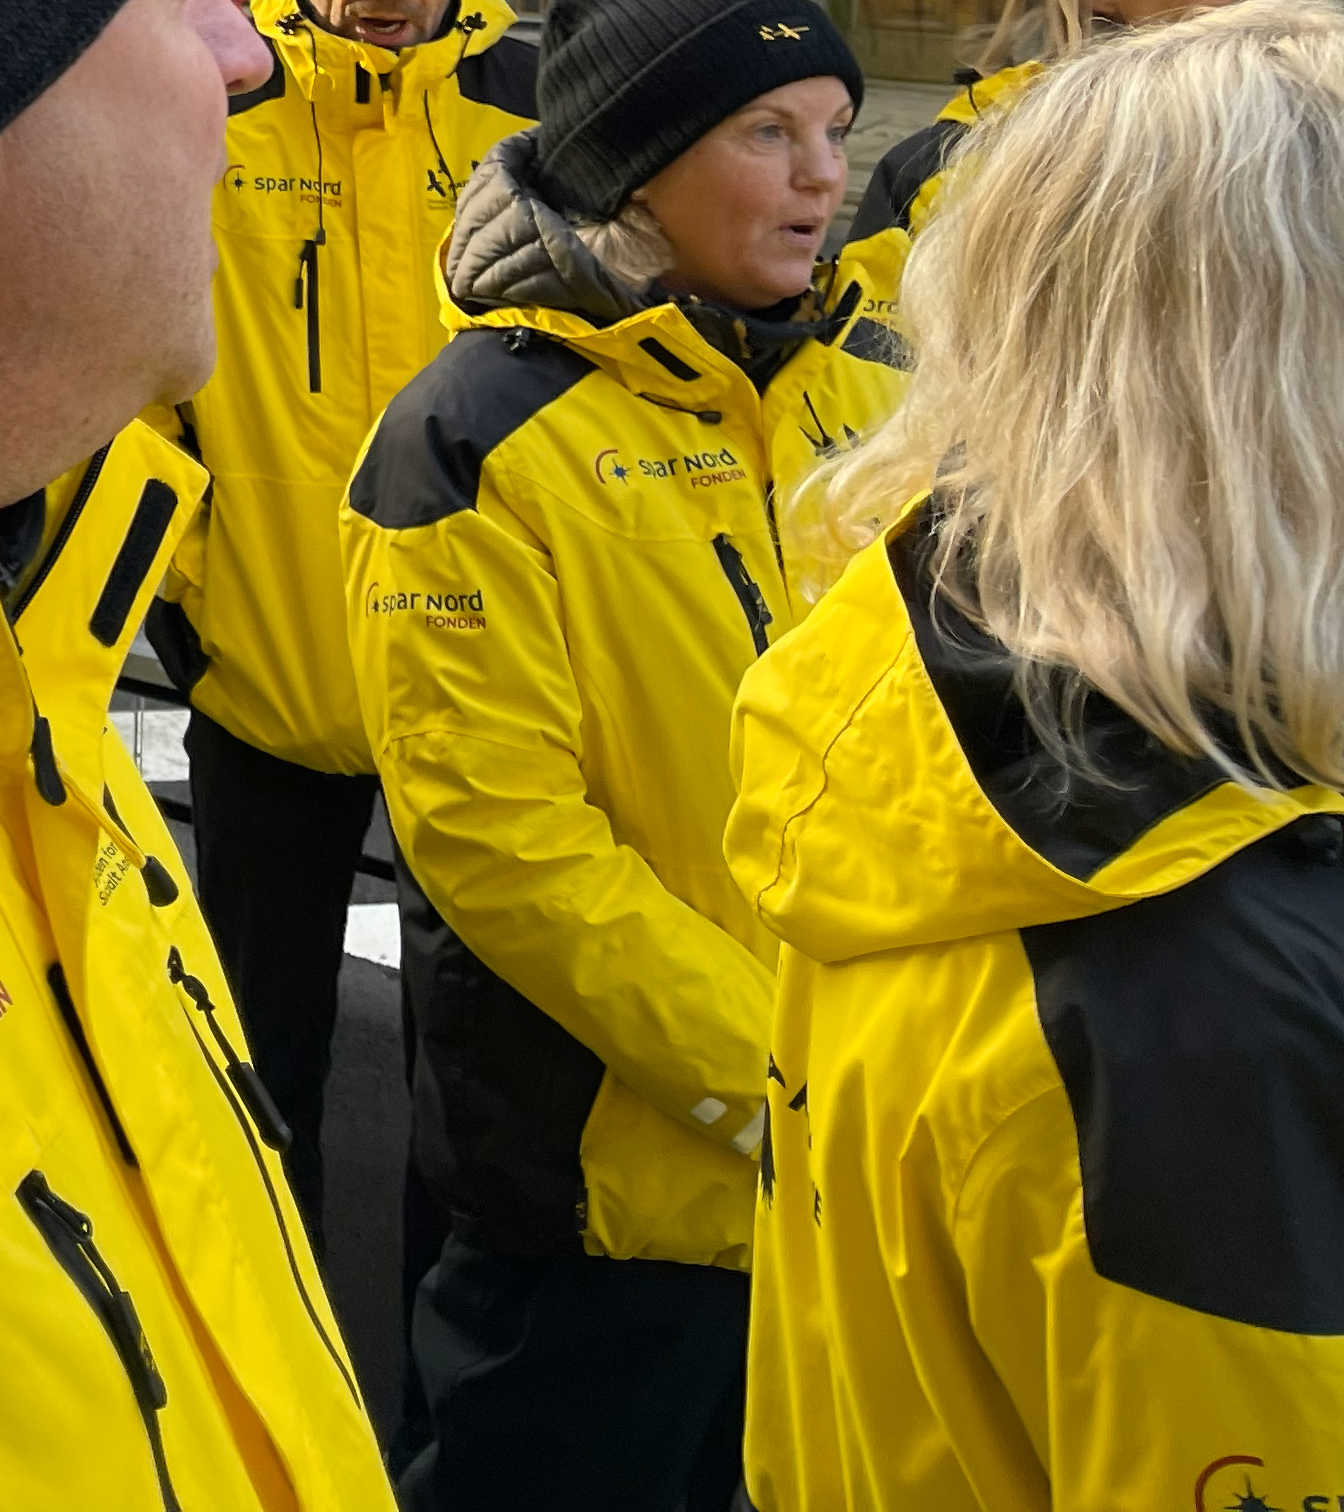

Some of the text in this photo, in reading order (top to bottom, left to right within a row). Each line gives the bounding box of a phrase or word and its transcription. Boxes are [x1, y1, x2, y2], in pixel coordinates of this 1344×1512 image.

[254, 176, 342, 196] spar Nord
[690, 469, 746, 489] FONDEN
[382, 589, 484, 616] spar Nord
[425, 615, 486, 629] FONDEN
